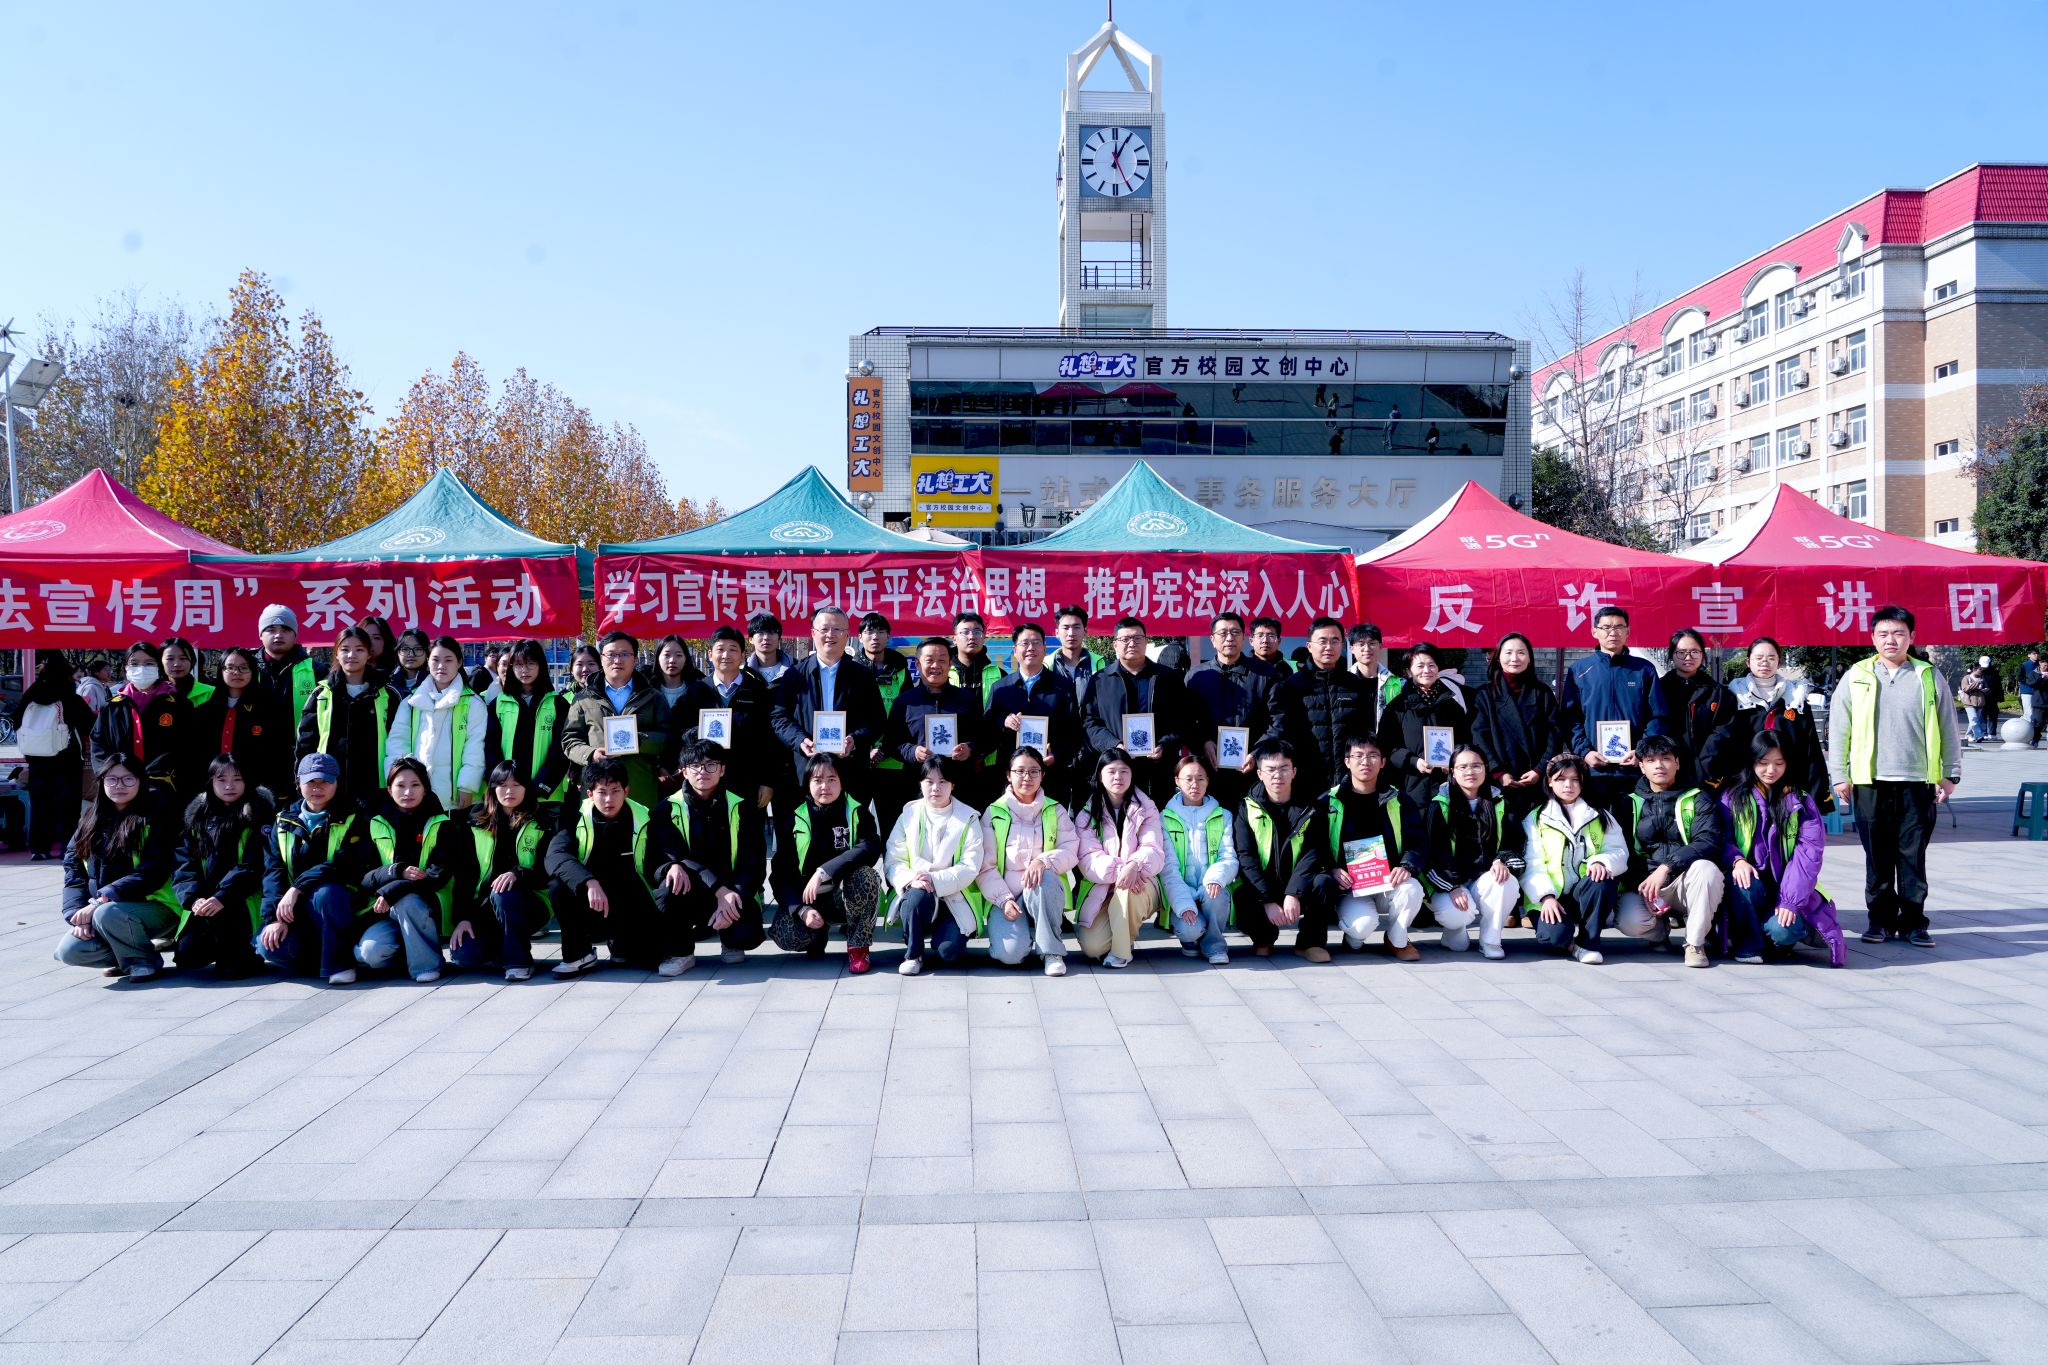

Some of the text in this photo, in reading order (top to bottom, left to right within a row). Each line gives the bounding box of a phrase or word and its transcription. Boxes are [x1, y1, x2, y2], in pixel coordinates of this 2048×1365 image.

[1059, 351, 1349, 378] 礼想工大 官方校园文创中心
[852, 388, 871, 477] 礼想工大
[872, 388, 881, 477] 官方校园文创中心
[916, 470, 993, 494] 礼想工大
[1001, 476, 1419, 509] 一站式事务服务大厅
[1042, 510, 1084, 525] 一杯
[301, 573, 543, 631] 系列活动
[1083, 566, 1350, 619] 推动宪法深入人心
[1423, 580, 2003, 633] 反诈宣讲团
